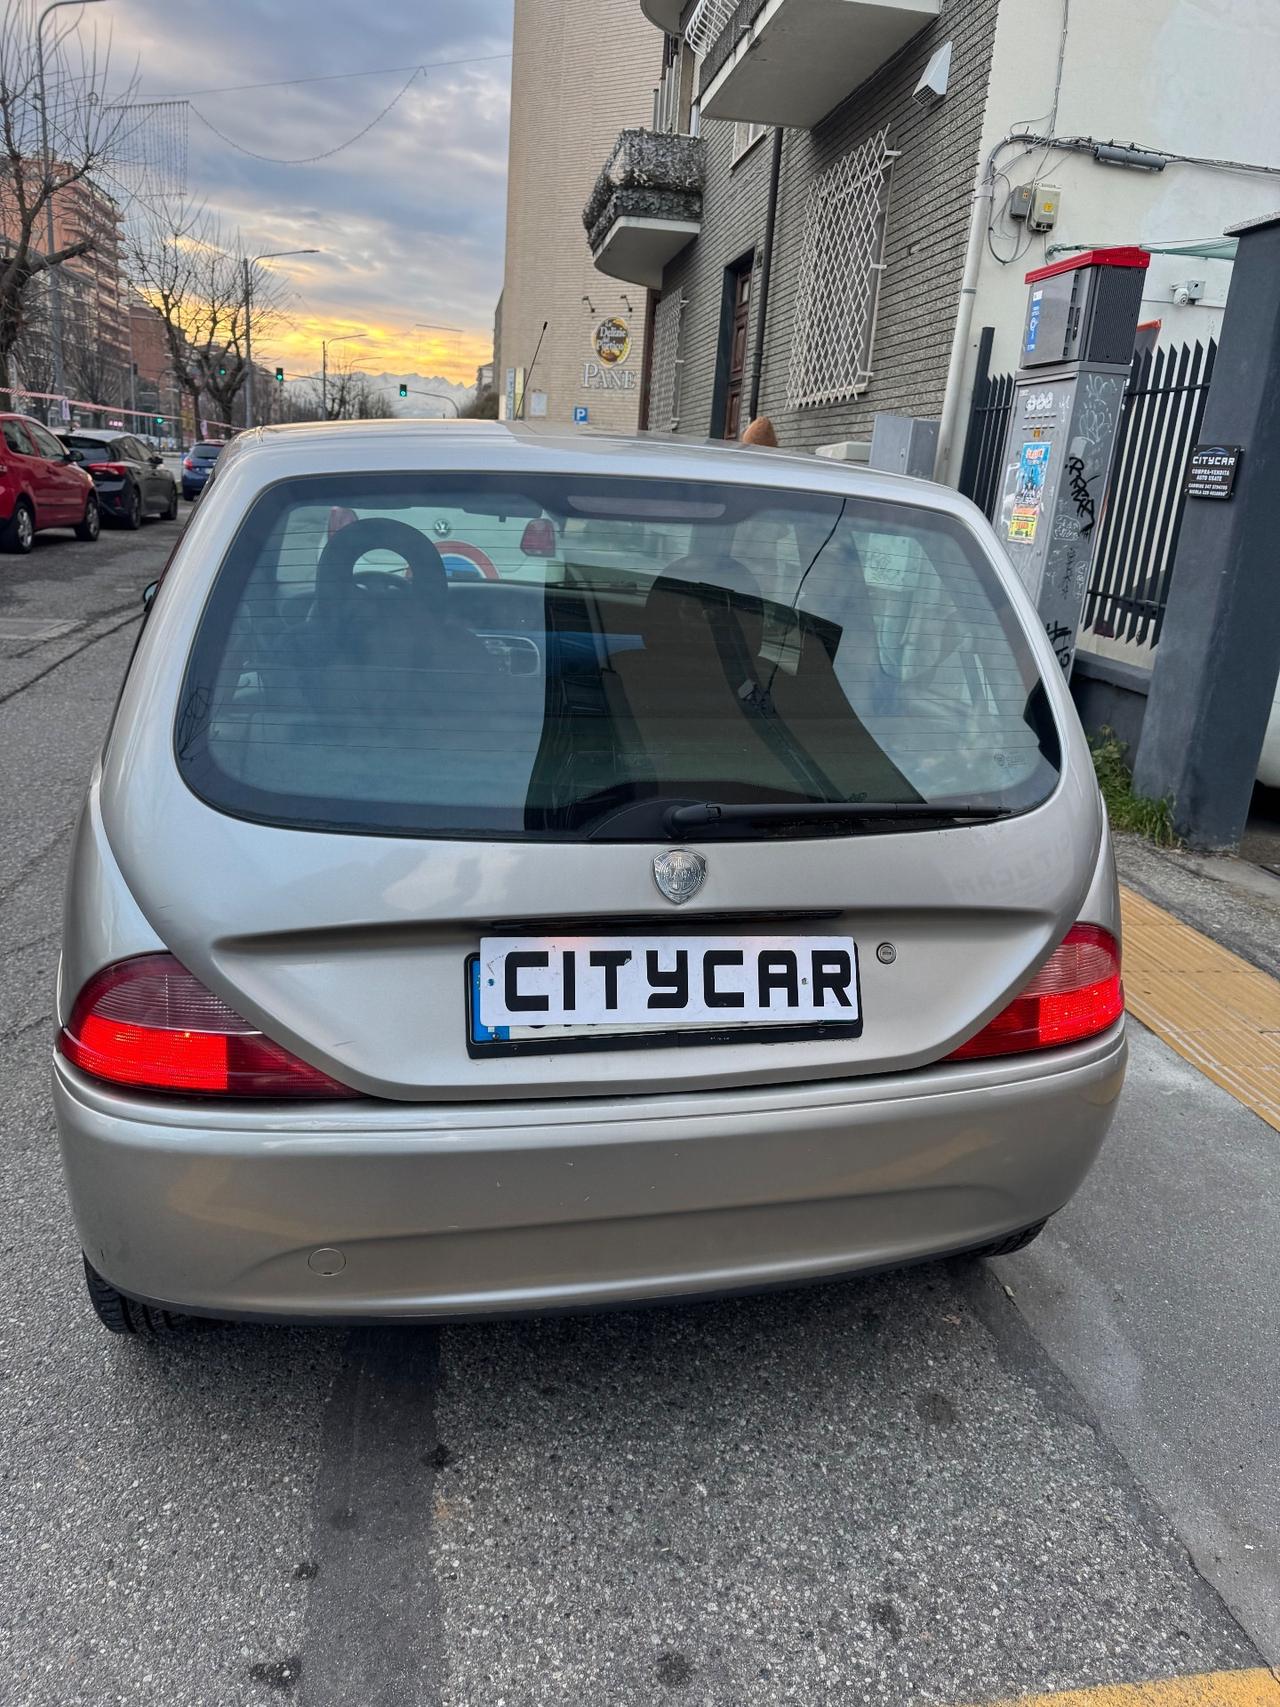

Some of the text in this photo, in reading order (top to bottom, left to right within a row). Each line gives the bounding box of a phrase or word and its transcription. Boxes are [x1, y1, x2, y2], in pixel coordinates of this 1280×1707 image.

[600, 326, 626, 337] Delizie
[582, 363, 636, 390] PANE
[576, 408, 586, 421] P
[1192, 456, 1235, 465] CITYCAR
[504, 949, 853, 1012] CITYCAR
